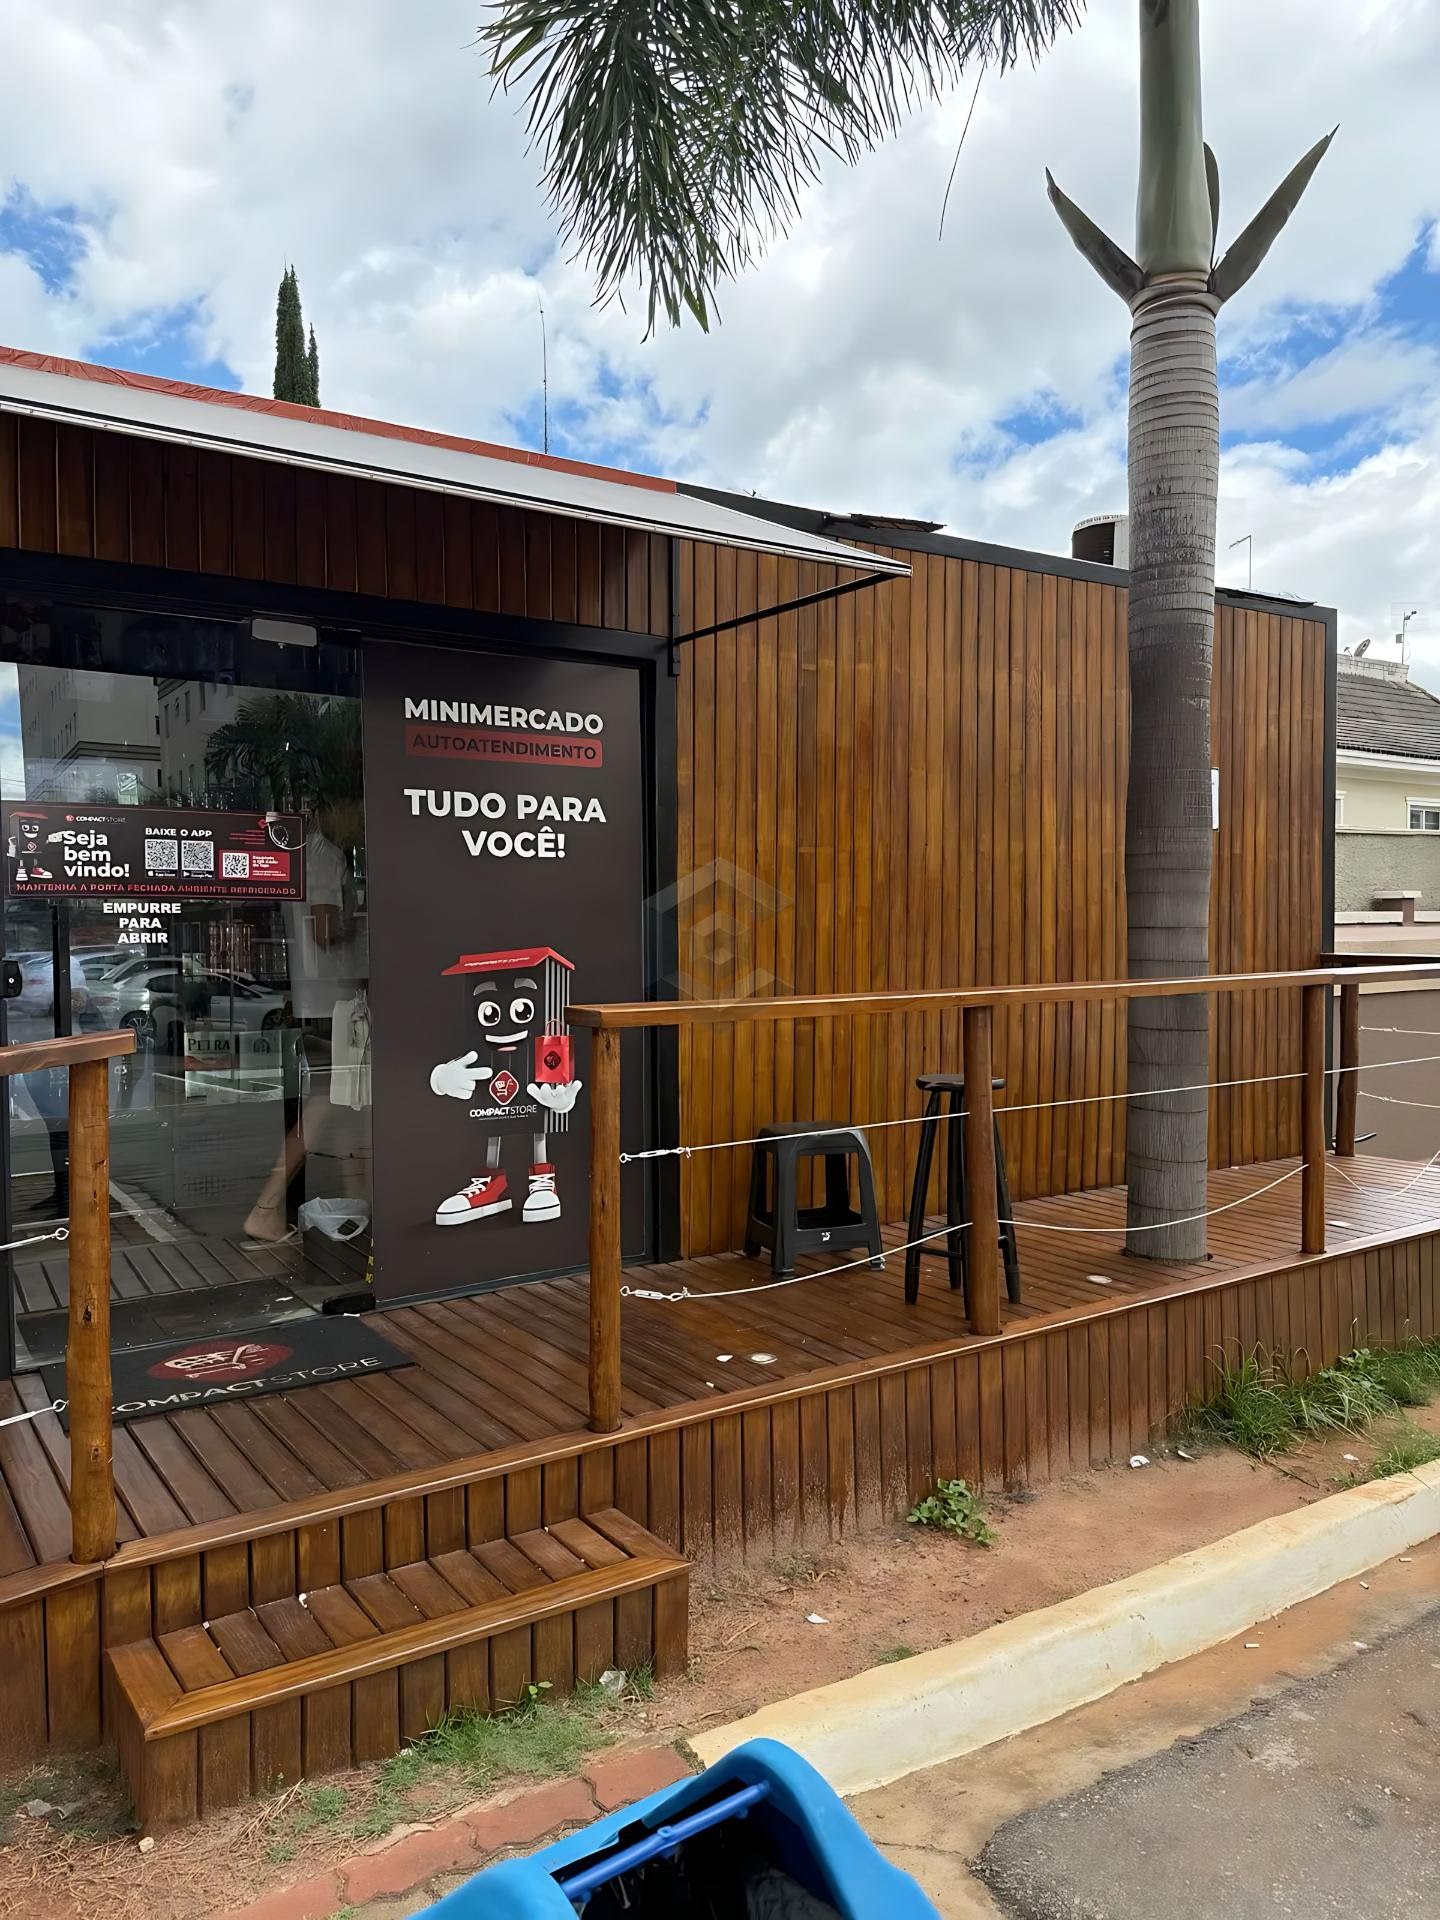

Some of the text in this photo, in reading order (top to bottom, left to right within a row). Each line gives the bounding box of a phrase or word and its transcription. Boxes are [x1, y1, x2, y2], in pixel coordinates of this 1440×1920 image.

[404, 697, 604, 734] MINIMERCADO
[412, 734, 596, 760] AUTOATENDIMENTO
[403, 788, 607, 823] TUDO PARA
[63, 829, 108, 849] Seja
[145, 827, 213, 838] BAIXE O APP
[461, 825, 566, 858] VOCÊ!
[64, 846, 111, 861] bem
[63, 861, 130, 877] vindo!
[16, 883, 77, 891] MANTENHA
[90, 883, 125, 891] PORTA
[127, 884, 175, 892] FECHADA
[103, 902, 182, 914] EMPURRE
[119, 917, 162, 929] PARA
[117, 932, 169, 944] ABRIR
[469, 1104, 538, 1118] COMPACTSTORE
